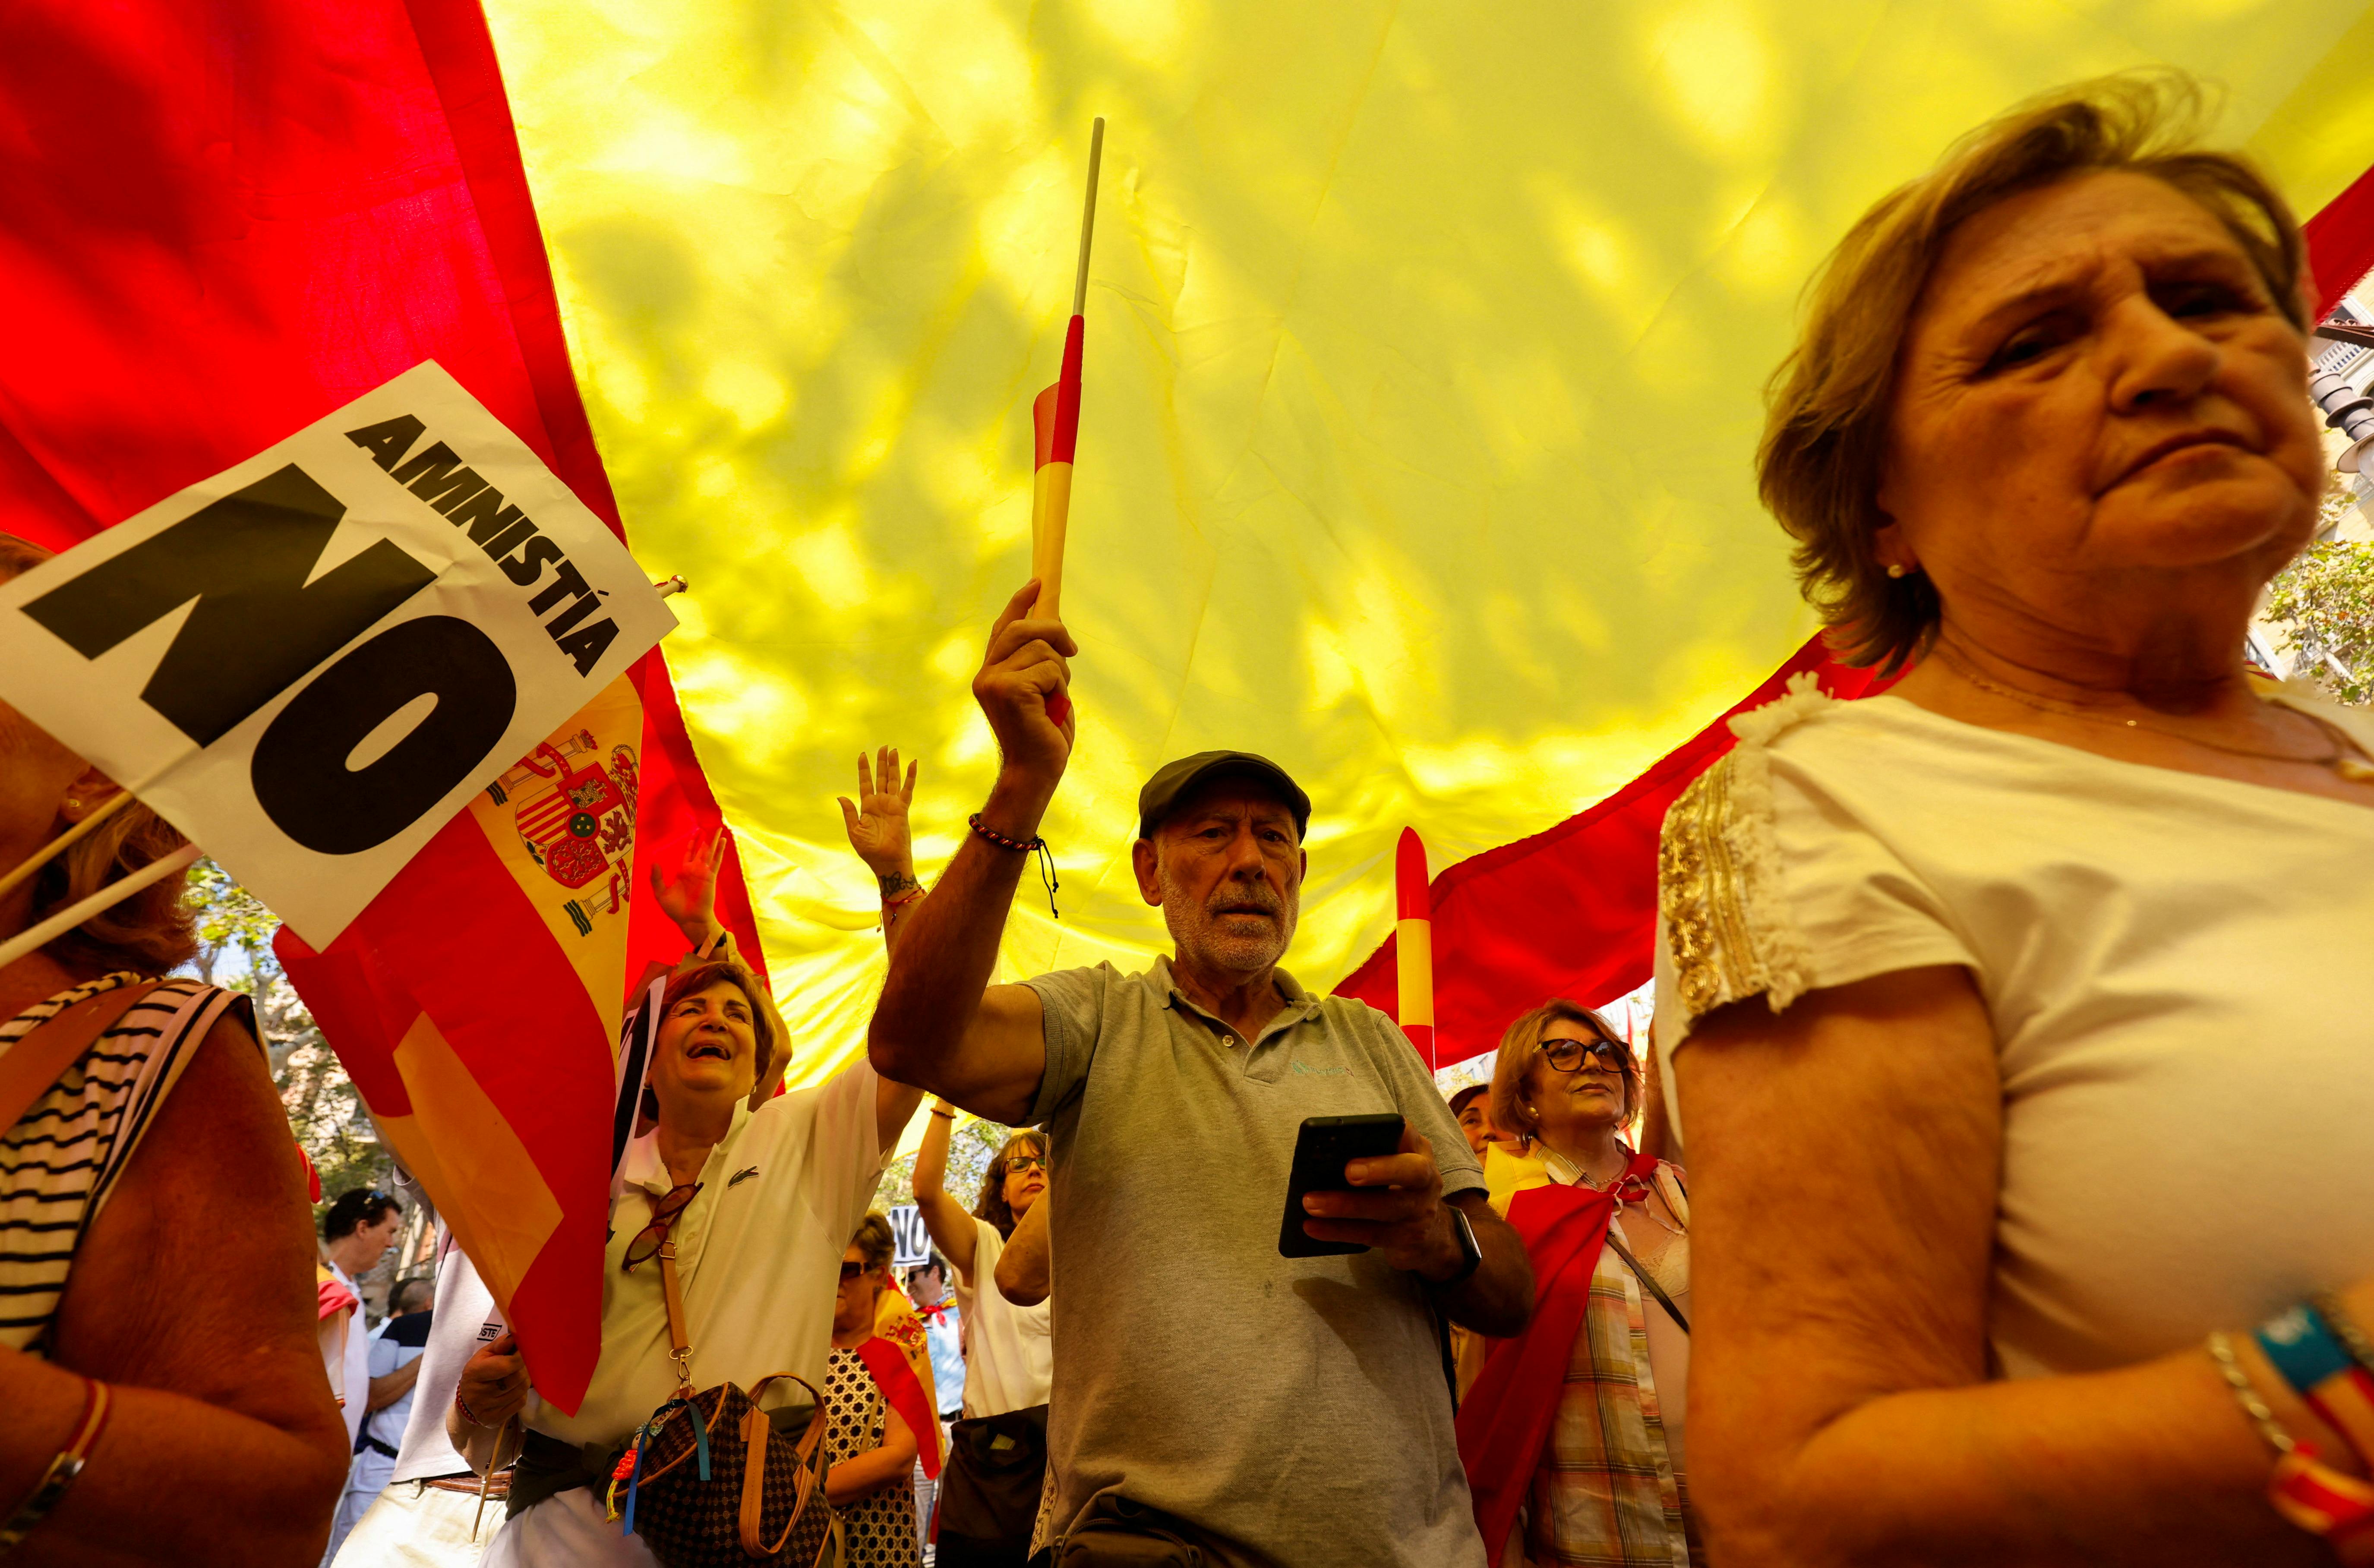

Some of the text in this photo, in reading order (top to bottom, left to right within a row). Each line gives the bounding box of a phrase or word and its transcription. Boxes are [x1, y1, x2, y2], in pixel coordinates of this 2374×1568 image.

[344, 414, 620, 678] AMNISTÍA
[20, 463, 517, 855] NO
[549, 750, 569, 771] PLVS
[892, 1208, 929, 1257] NO
[479, 1328, 498, 1338] STE
